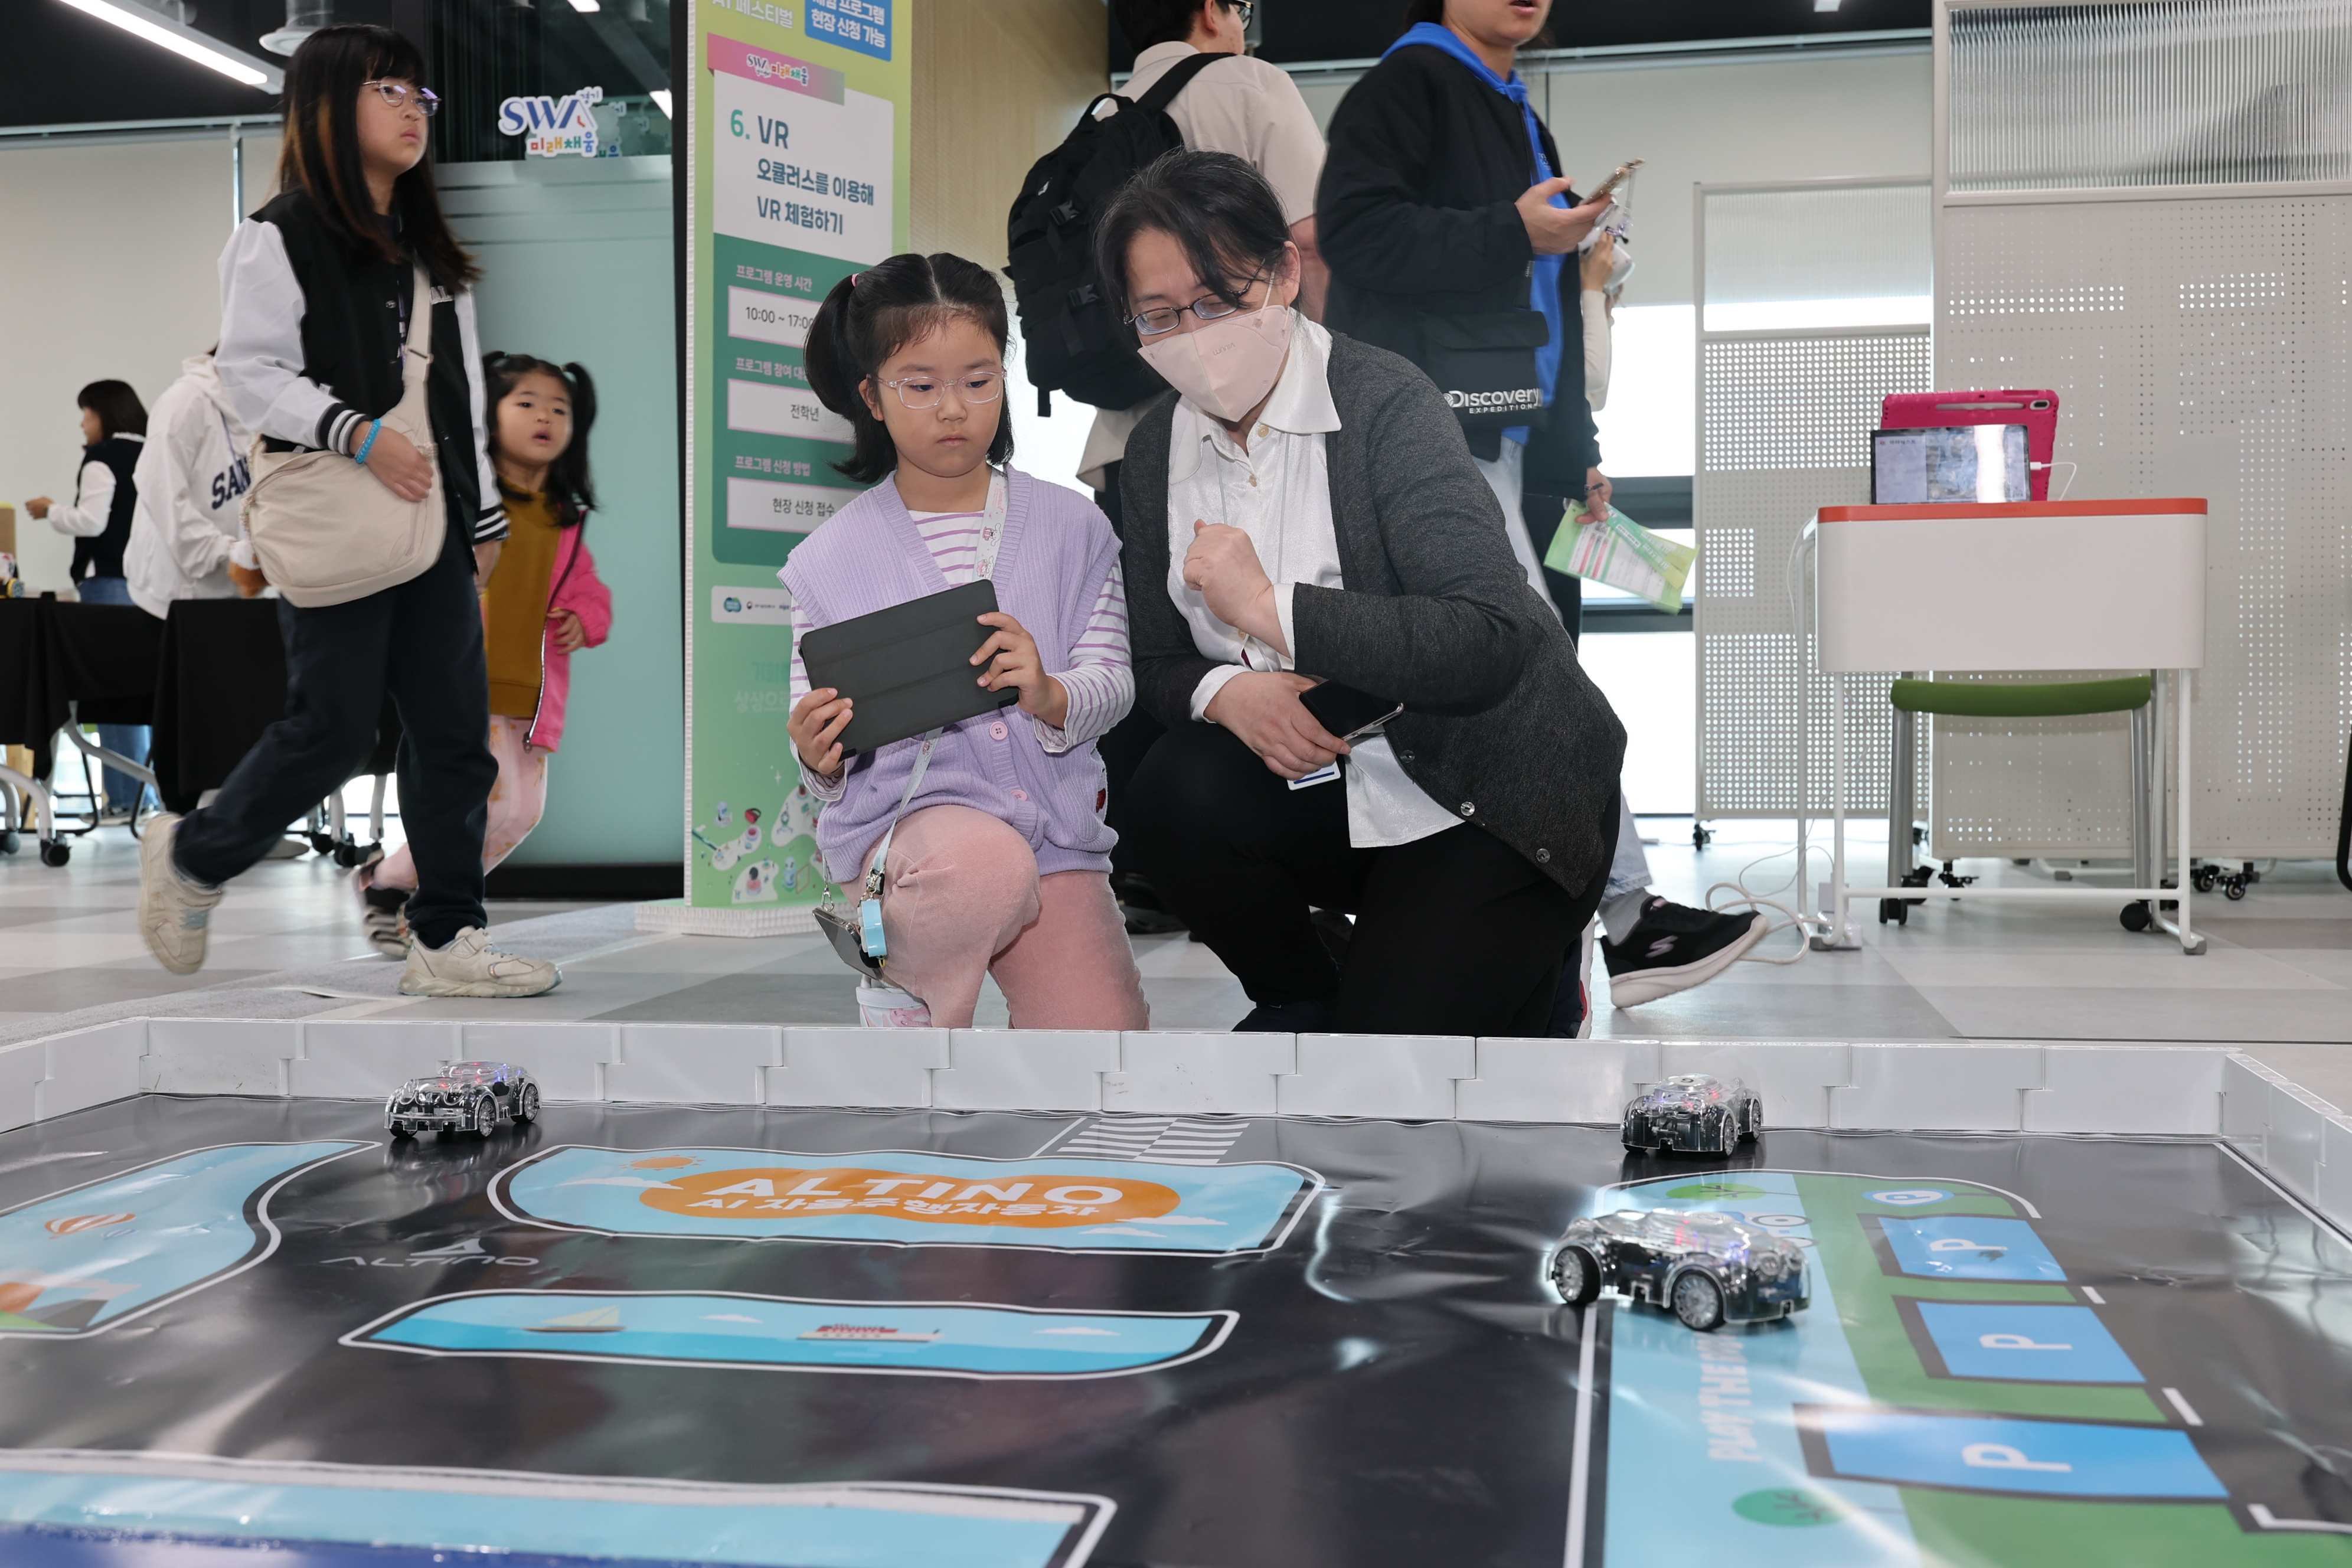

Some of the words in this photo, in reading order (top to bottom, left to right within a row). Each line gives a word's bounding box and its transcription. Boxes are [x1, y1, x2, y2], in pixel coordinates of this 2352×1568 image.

[736, 0, 793, 28] 페스티벌
[838, 0, 884, 25] 프로그램
[811, 9, 836, 32] 현장
[837, 18, 861, 41] 신청
[863, 25, 886, 48] 가능
[730, 109, 750, 140] 6.
[757, 116, 789, 149] VR
[531, 132, 594, 153] 미래채움
[757, 158, 829, 195] 오큘러스를
[833, 177, 874, 205] 이용해
[757, 196, 780, 221] VR
[785, 201, 843, 235] 체험하기
[736, 265, 773, 284] 프로그램
[775, 272, 792, 288] 운영
[794, 277, 812, 292] 시간
[746, 306, 775, 323] 10:00
[736, 357, 772, 376] 프로그램
[774, 364, 792, 378] 참여
[1449, 388, 1541, 407] Discovery
[790, 404, 819, 421] 전학년
[1469, 404, 1533, 413] EXPEDITION
[735, 456, 771, 472] 프로그램
[773, 460, 791, 474] 신청
[793, 462, 811, 476] 방법
[773, 498, 792, 514] 현장
[795, 500, 813, 515] 신청
[816, 501, 835, 518] 접수
[701, 1177, 1123, 1204] ALTINO
[685, 1198, 749, 1208] AI
